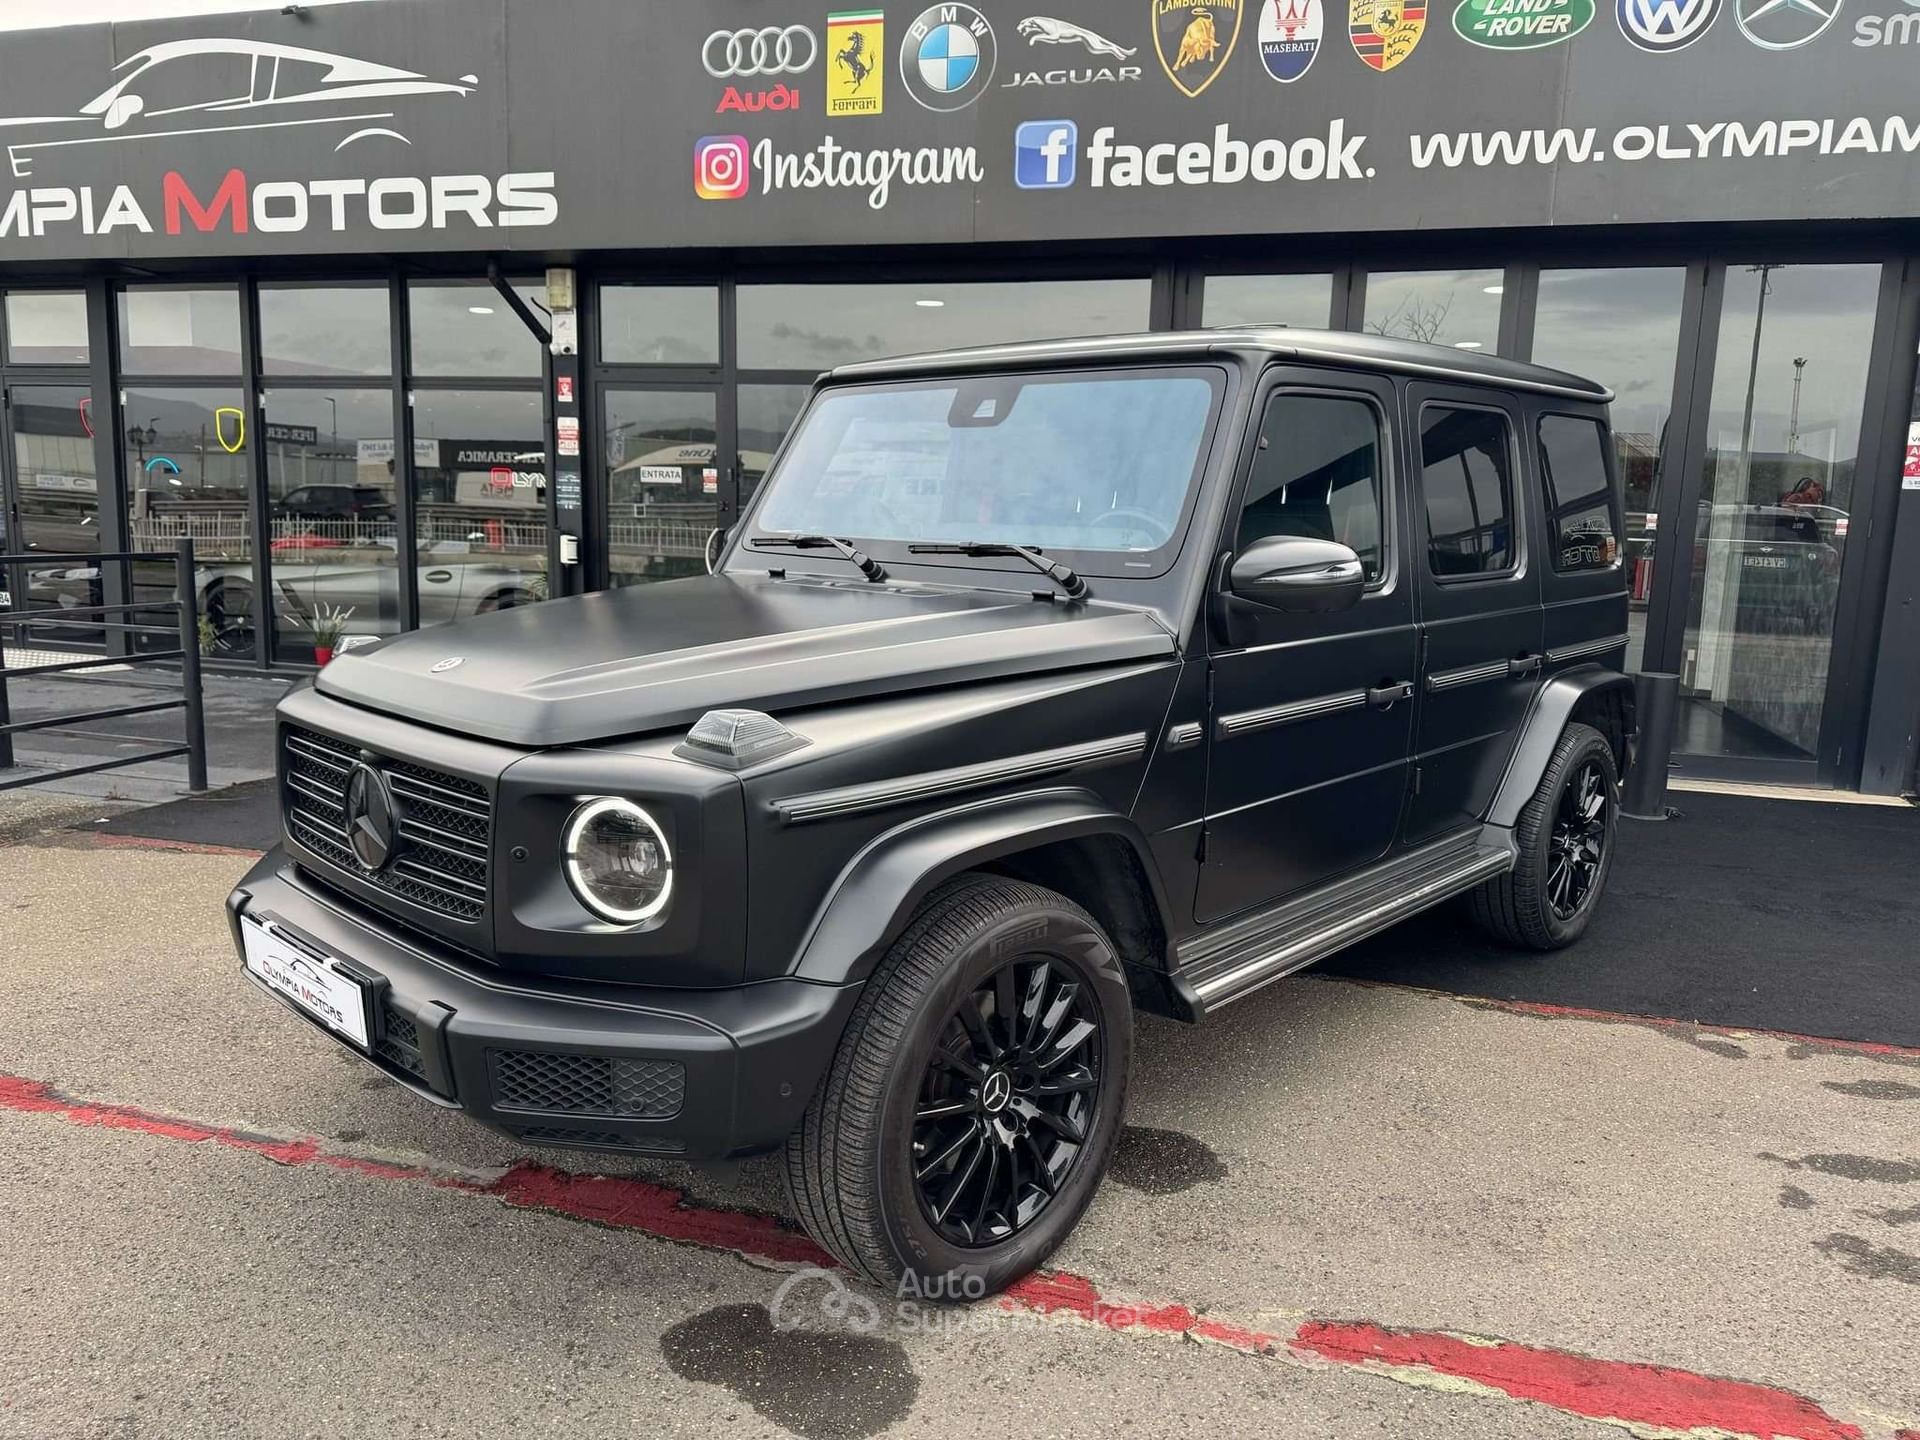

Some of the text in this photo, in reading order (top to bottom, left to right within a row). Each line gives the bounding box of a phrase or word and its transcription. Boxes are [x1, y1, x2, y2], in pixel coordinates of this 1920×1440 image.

[1483, 0, 1549, 15] LAND
[910, 6, 989, 41] BMW
[1487, 14, 1572, 37] ROVER
[1263, 42, 1316, 54] MASERATI
[1001, 66, 1142, 88] JAGUAR
[832, 97, 878, 111] Ferrari
[753, 136, 984, 209] Instagram
[163, 168, 558, 235] MOTORS
[641, 470, 681, 480] ENTRATA
[263, 960, 343, 1023] OLYMPIA MOTORS
